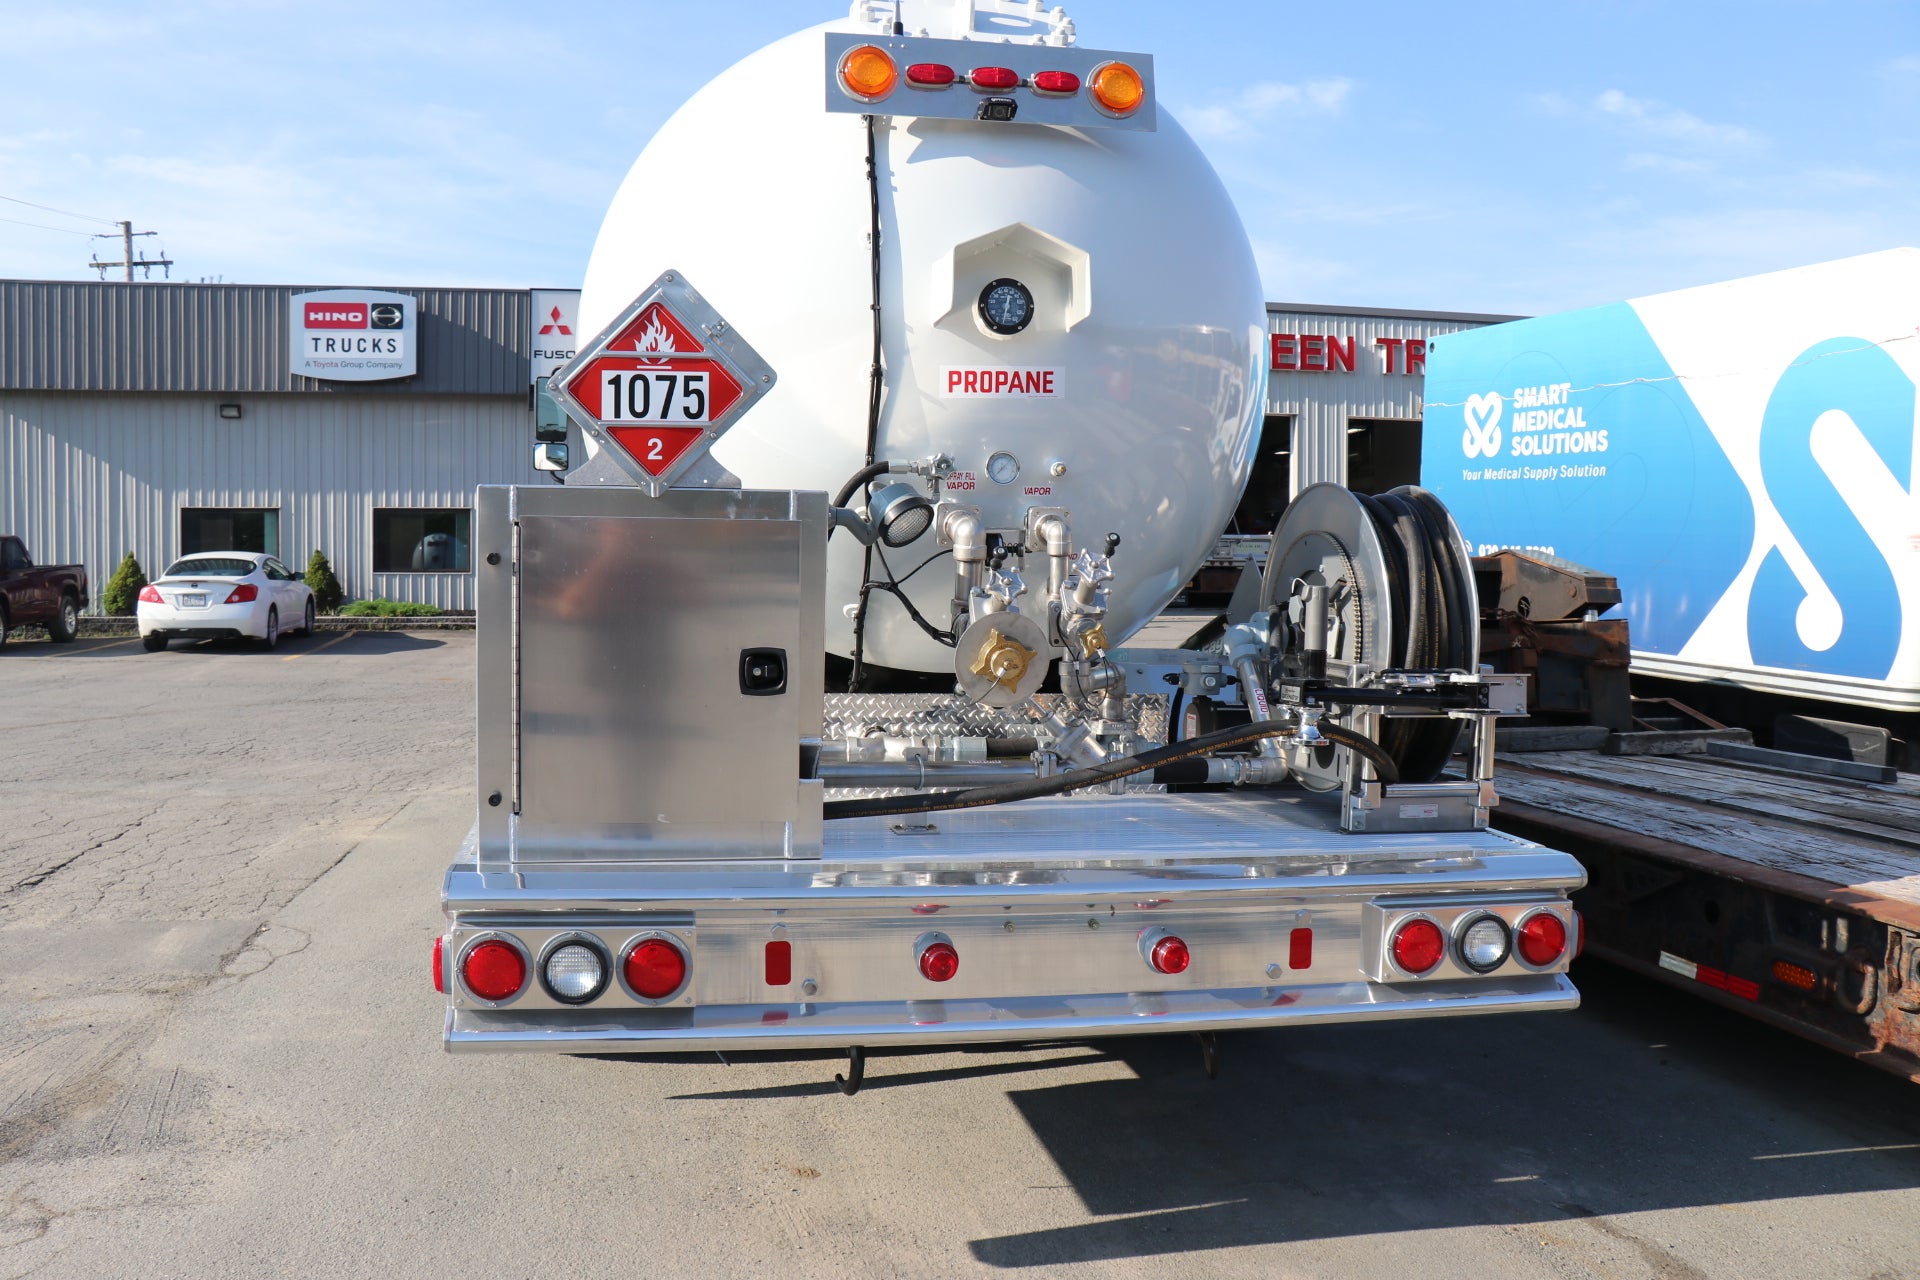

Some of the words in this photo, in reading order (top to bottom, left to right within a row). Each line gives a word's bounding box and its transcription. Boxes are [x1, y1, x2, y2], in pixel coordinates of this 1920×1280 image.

[309, 312, 363, 322] HINO
[312, 338, 397, 353] TRUCKS
[1271, 333, 1355, 372] EEN
[313, 361, 339, 369] Toyota
[340, 361, 364, 369] Group
[366, 361, 403, 369] Company
[948, 370, 1054, 394] PROPANE
[607, 374, 705, 420] 1075
[1513, 382, 1572, 409] SMART
[1511, 406, 1587, 433] MEDICAL
[647, 437, 663, 460] 2
[1511, 429, 1609, 457] SOLUTIONS
[948, 472, 963, 481] PRAY
[1462, 469, 1482, 481] Your
[1484, 466, 1521, 480] Medical
[1523, 465, 1558, 481] Supply
[1560, 463, 1607, 478] Solution
[946, 481, 976, 490] VAPOR
[1024, 487, 1051, 496] VAPOR
[1254, 689, 1269, 713] LIQUID
